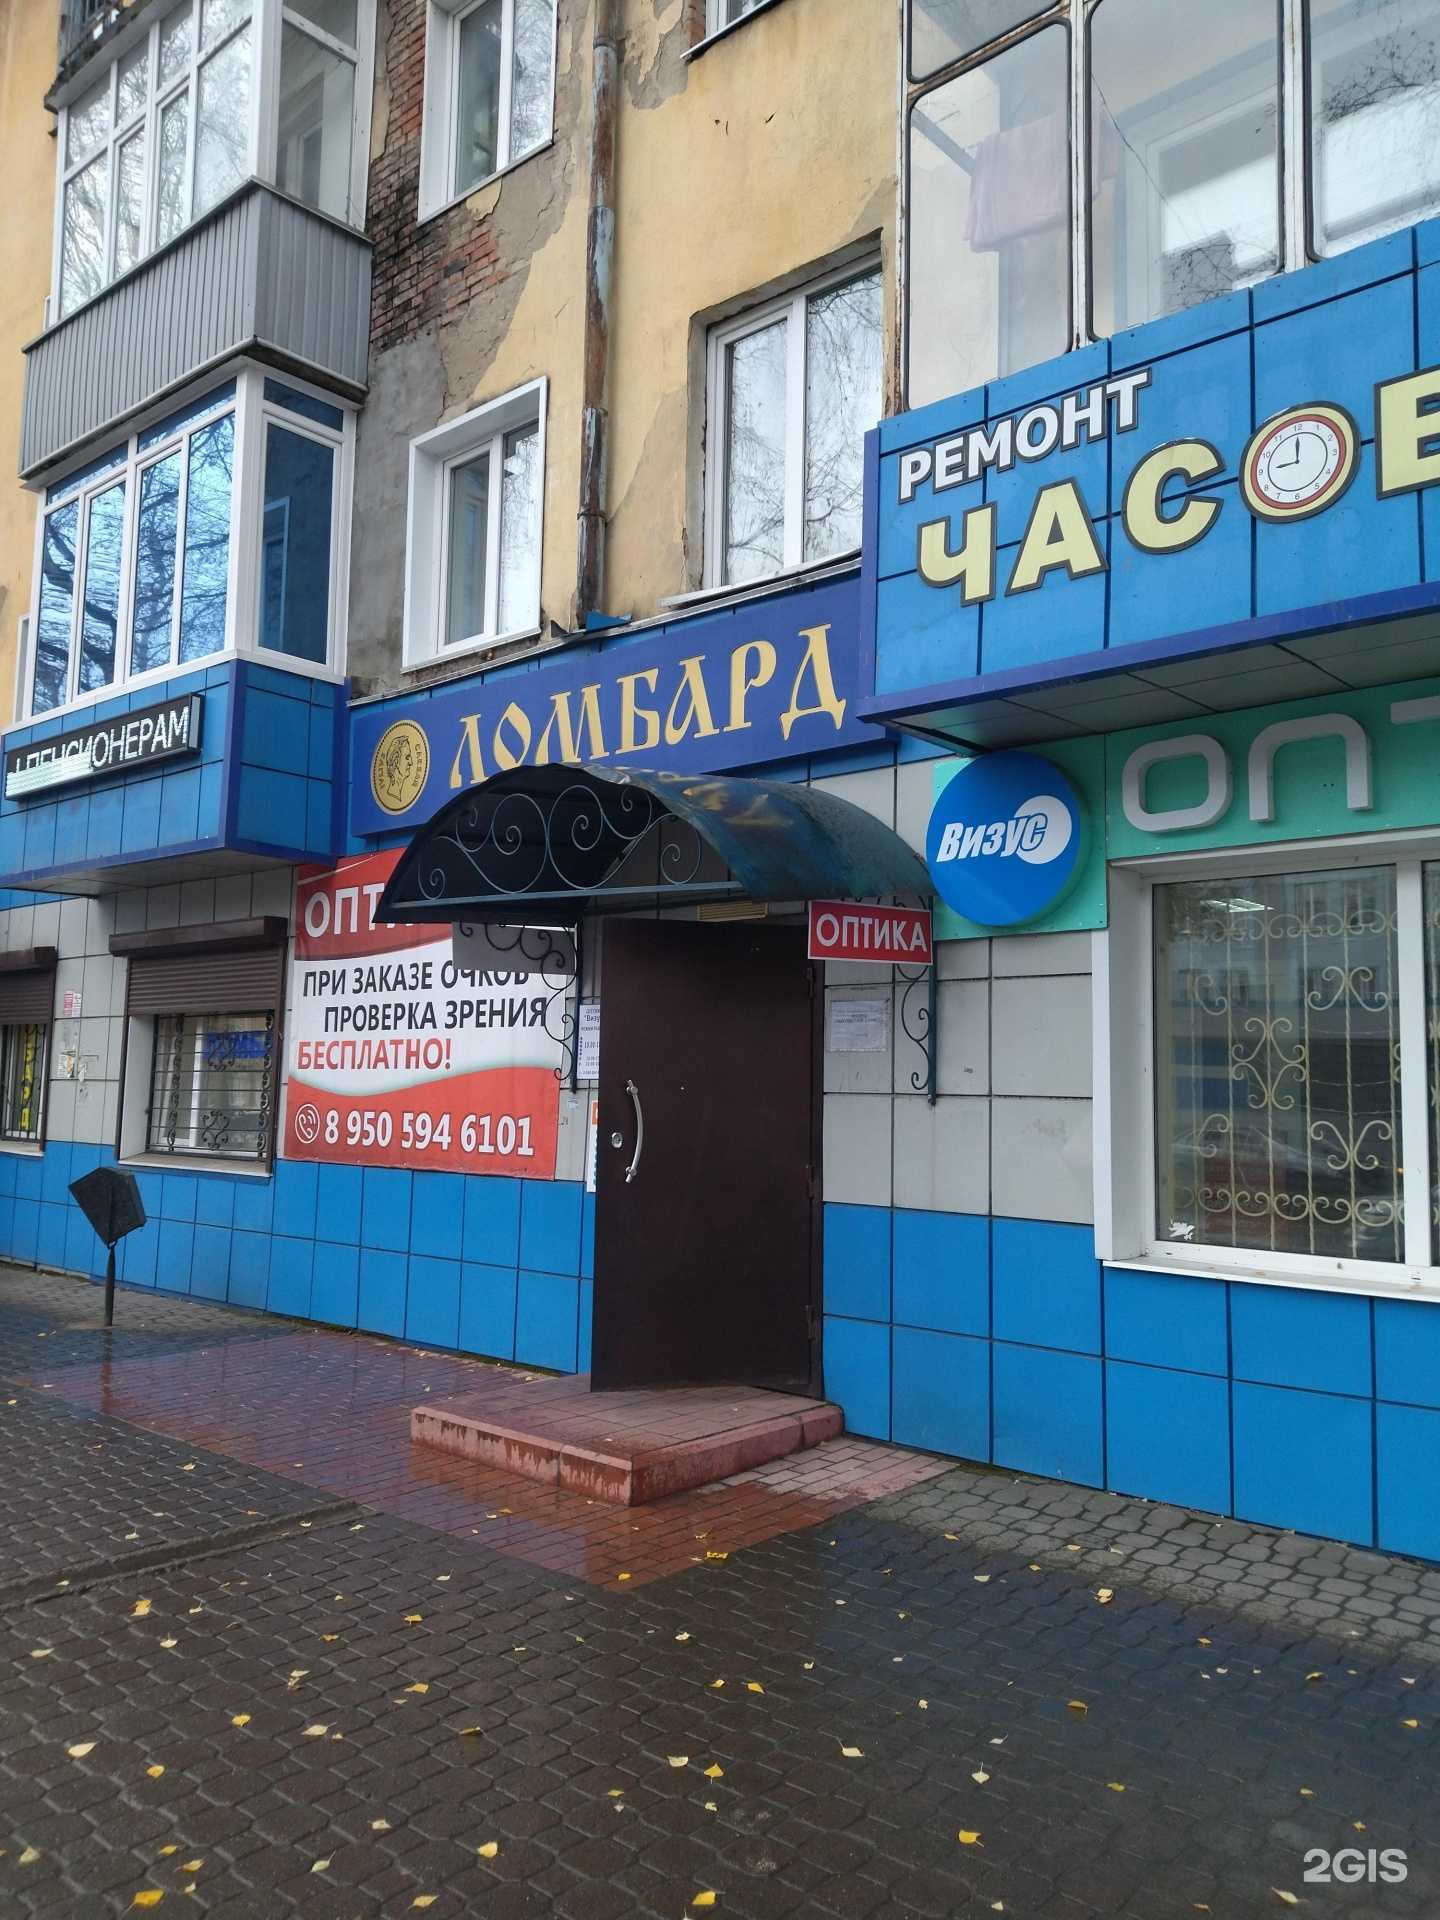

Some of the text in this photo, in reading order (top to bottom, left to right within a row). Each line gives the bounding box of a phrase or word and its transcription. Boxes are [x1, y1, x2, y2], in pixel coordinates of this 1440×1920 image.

[898, 367, 1152, 503] РЕМОНТ
[448, 624, 847, 789] ЛОМБАРД
[1122, 696, 1440, 834] ОП
[816, 913, 928, 952] ОПТИКА
[303, 969, 346, 997] ПРИ
[352, 961, 433, 994] ЗАКАЗЕ
[324, 997, 548, 1032] ПРОВЕРКА ЗРЕНИЯ
[297, 1037, 451, 1070] БЕСПЛАТНО!
[325, 1110, 534, 1156] 8 950 594 6101
